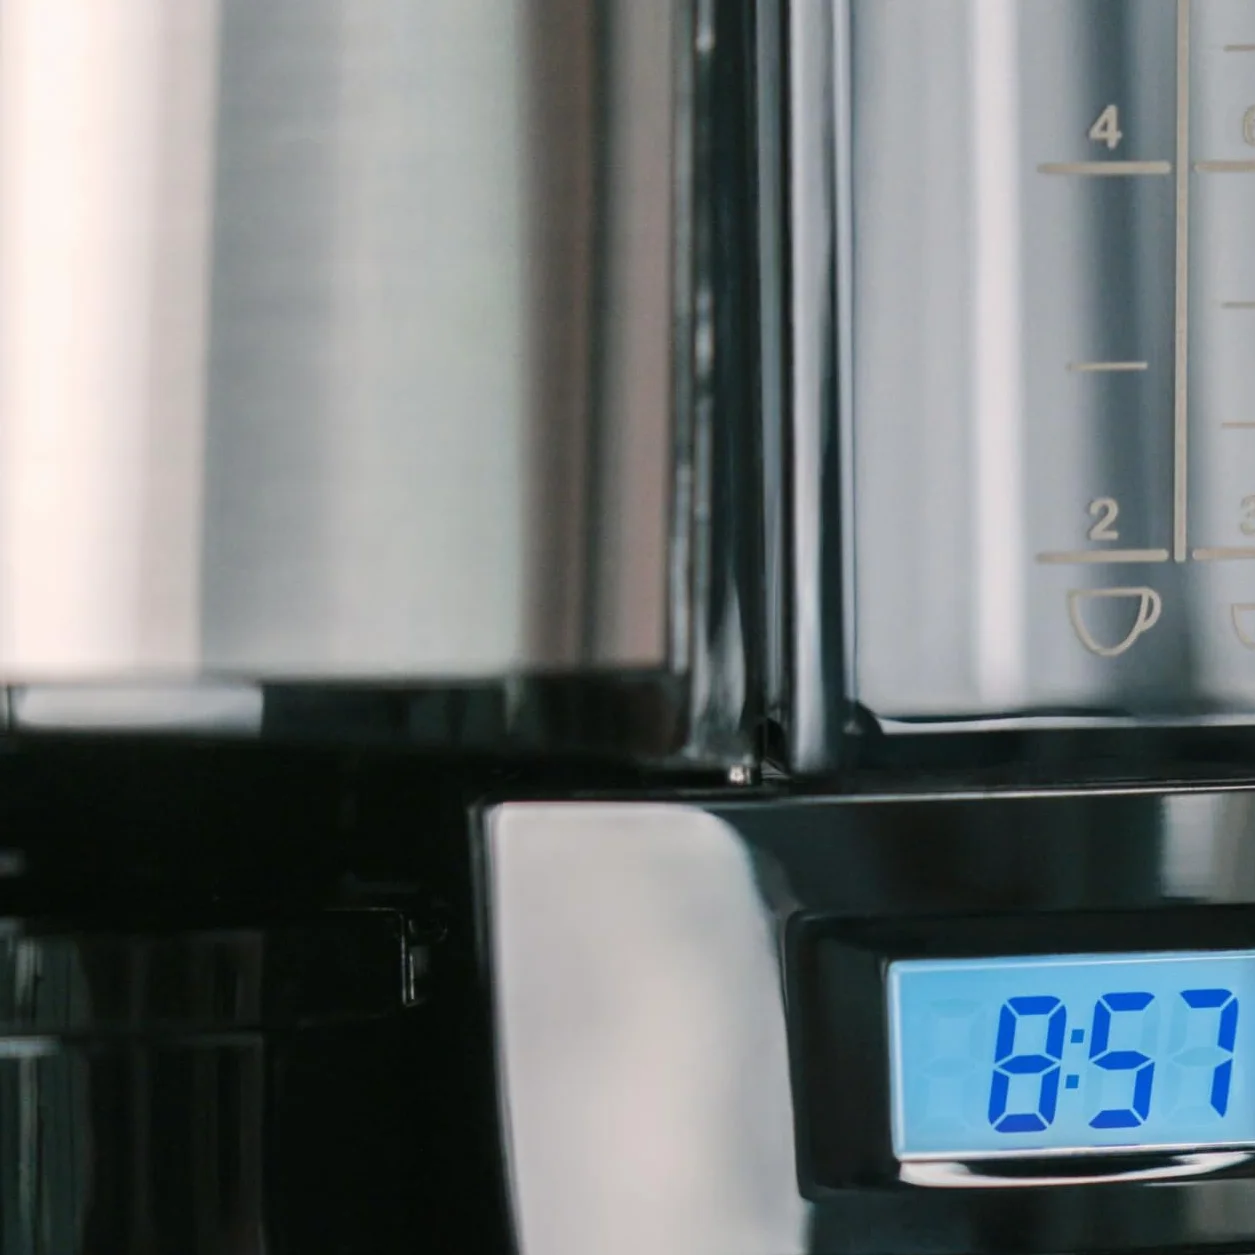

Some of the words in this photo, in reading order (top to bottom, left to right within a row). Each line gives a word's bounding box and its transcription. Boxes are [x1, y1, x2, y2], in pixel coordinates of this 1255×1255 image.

[1088, 104, 1122, 149] 4
[1088, 497, 1119, 540] 2
[988, 988, 1239, 1133] 8:57
